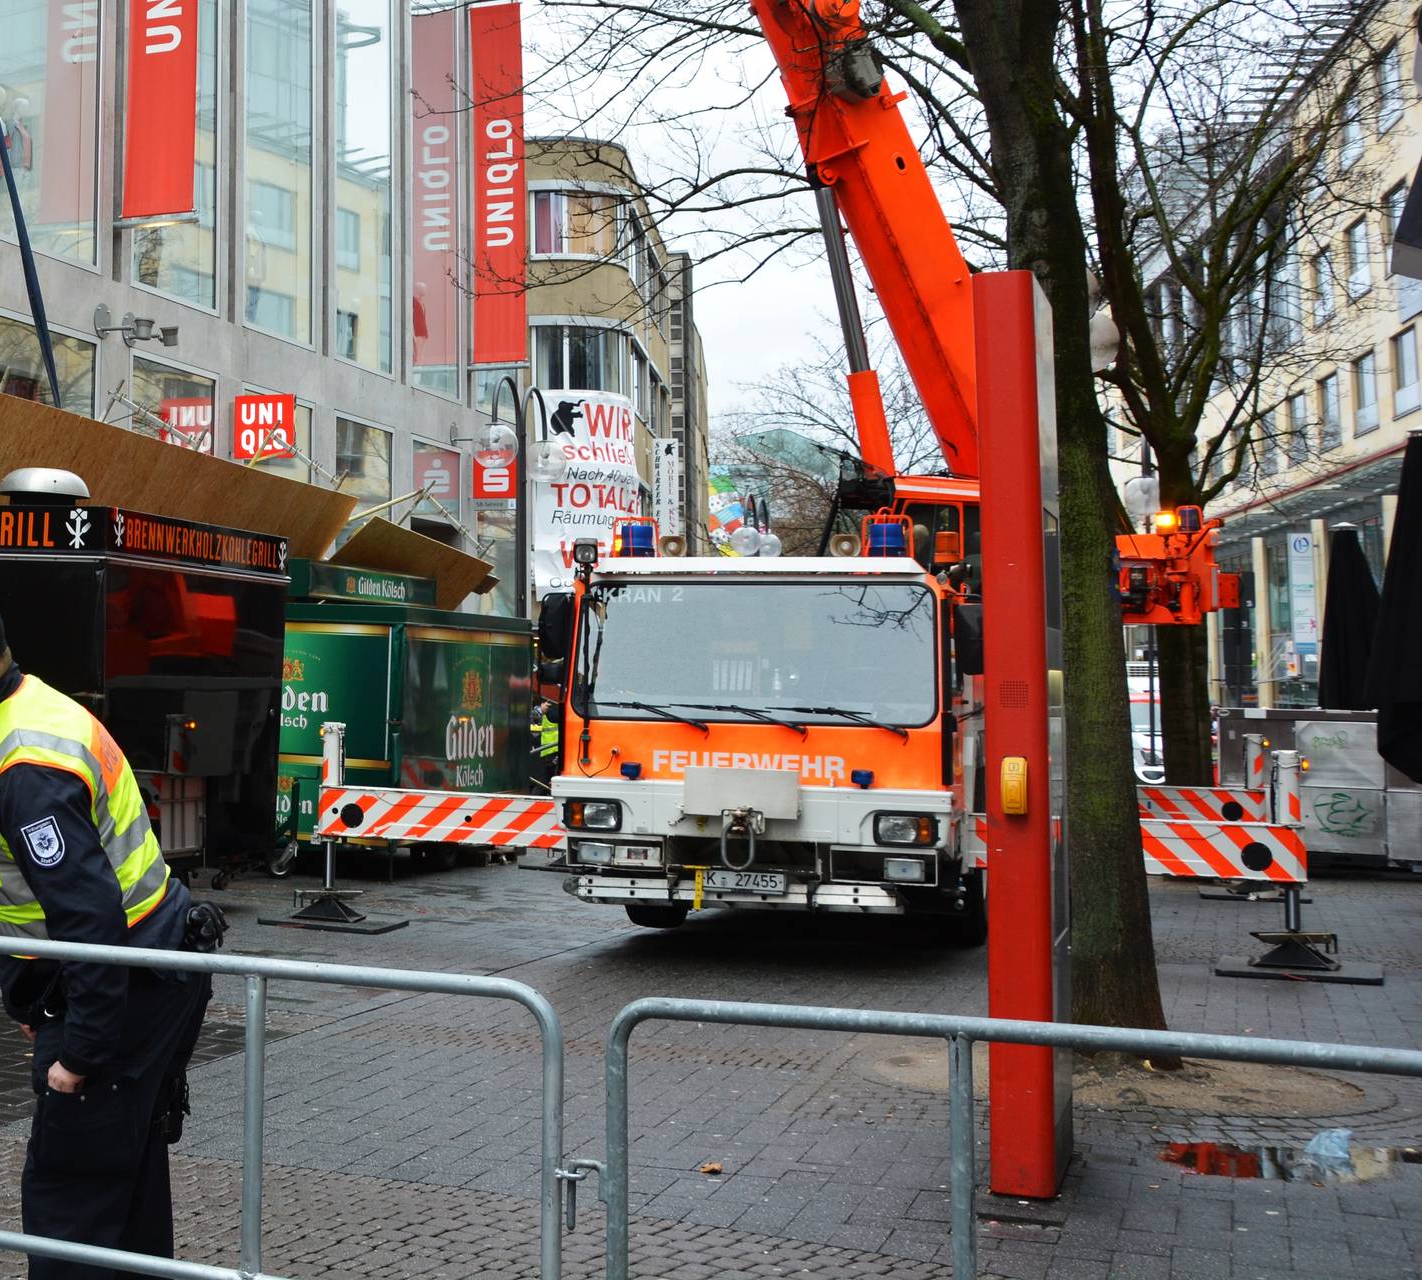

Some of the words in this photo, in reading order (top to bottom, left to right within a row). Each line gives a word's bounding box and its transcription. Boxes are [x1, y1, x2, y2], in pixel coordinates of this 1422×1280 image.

[486, 119, 519, 247] UNIQLO
[241, 402, 283, 425] UNI
[241, 428, 287, 455] QLO
[566, 466, 604, 481] Nach
[358, 576, 381, 597] Gilden
[382, 579, 406, 601] Kölsch
[603, 587, 661, 602] KRAN
[671, 586, 684, 602] 2
[281, 685, 328, 713] den
[280, 714, 308, 729] lsch
[445, 715, 494, 760] Gilden
[456, 763, 484, 788] Kölsch
[652, 750, 845, 779] FEUERWEHR
[705, 872, 716, 885] K
[735, 873, 778, 888] 27455
